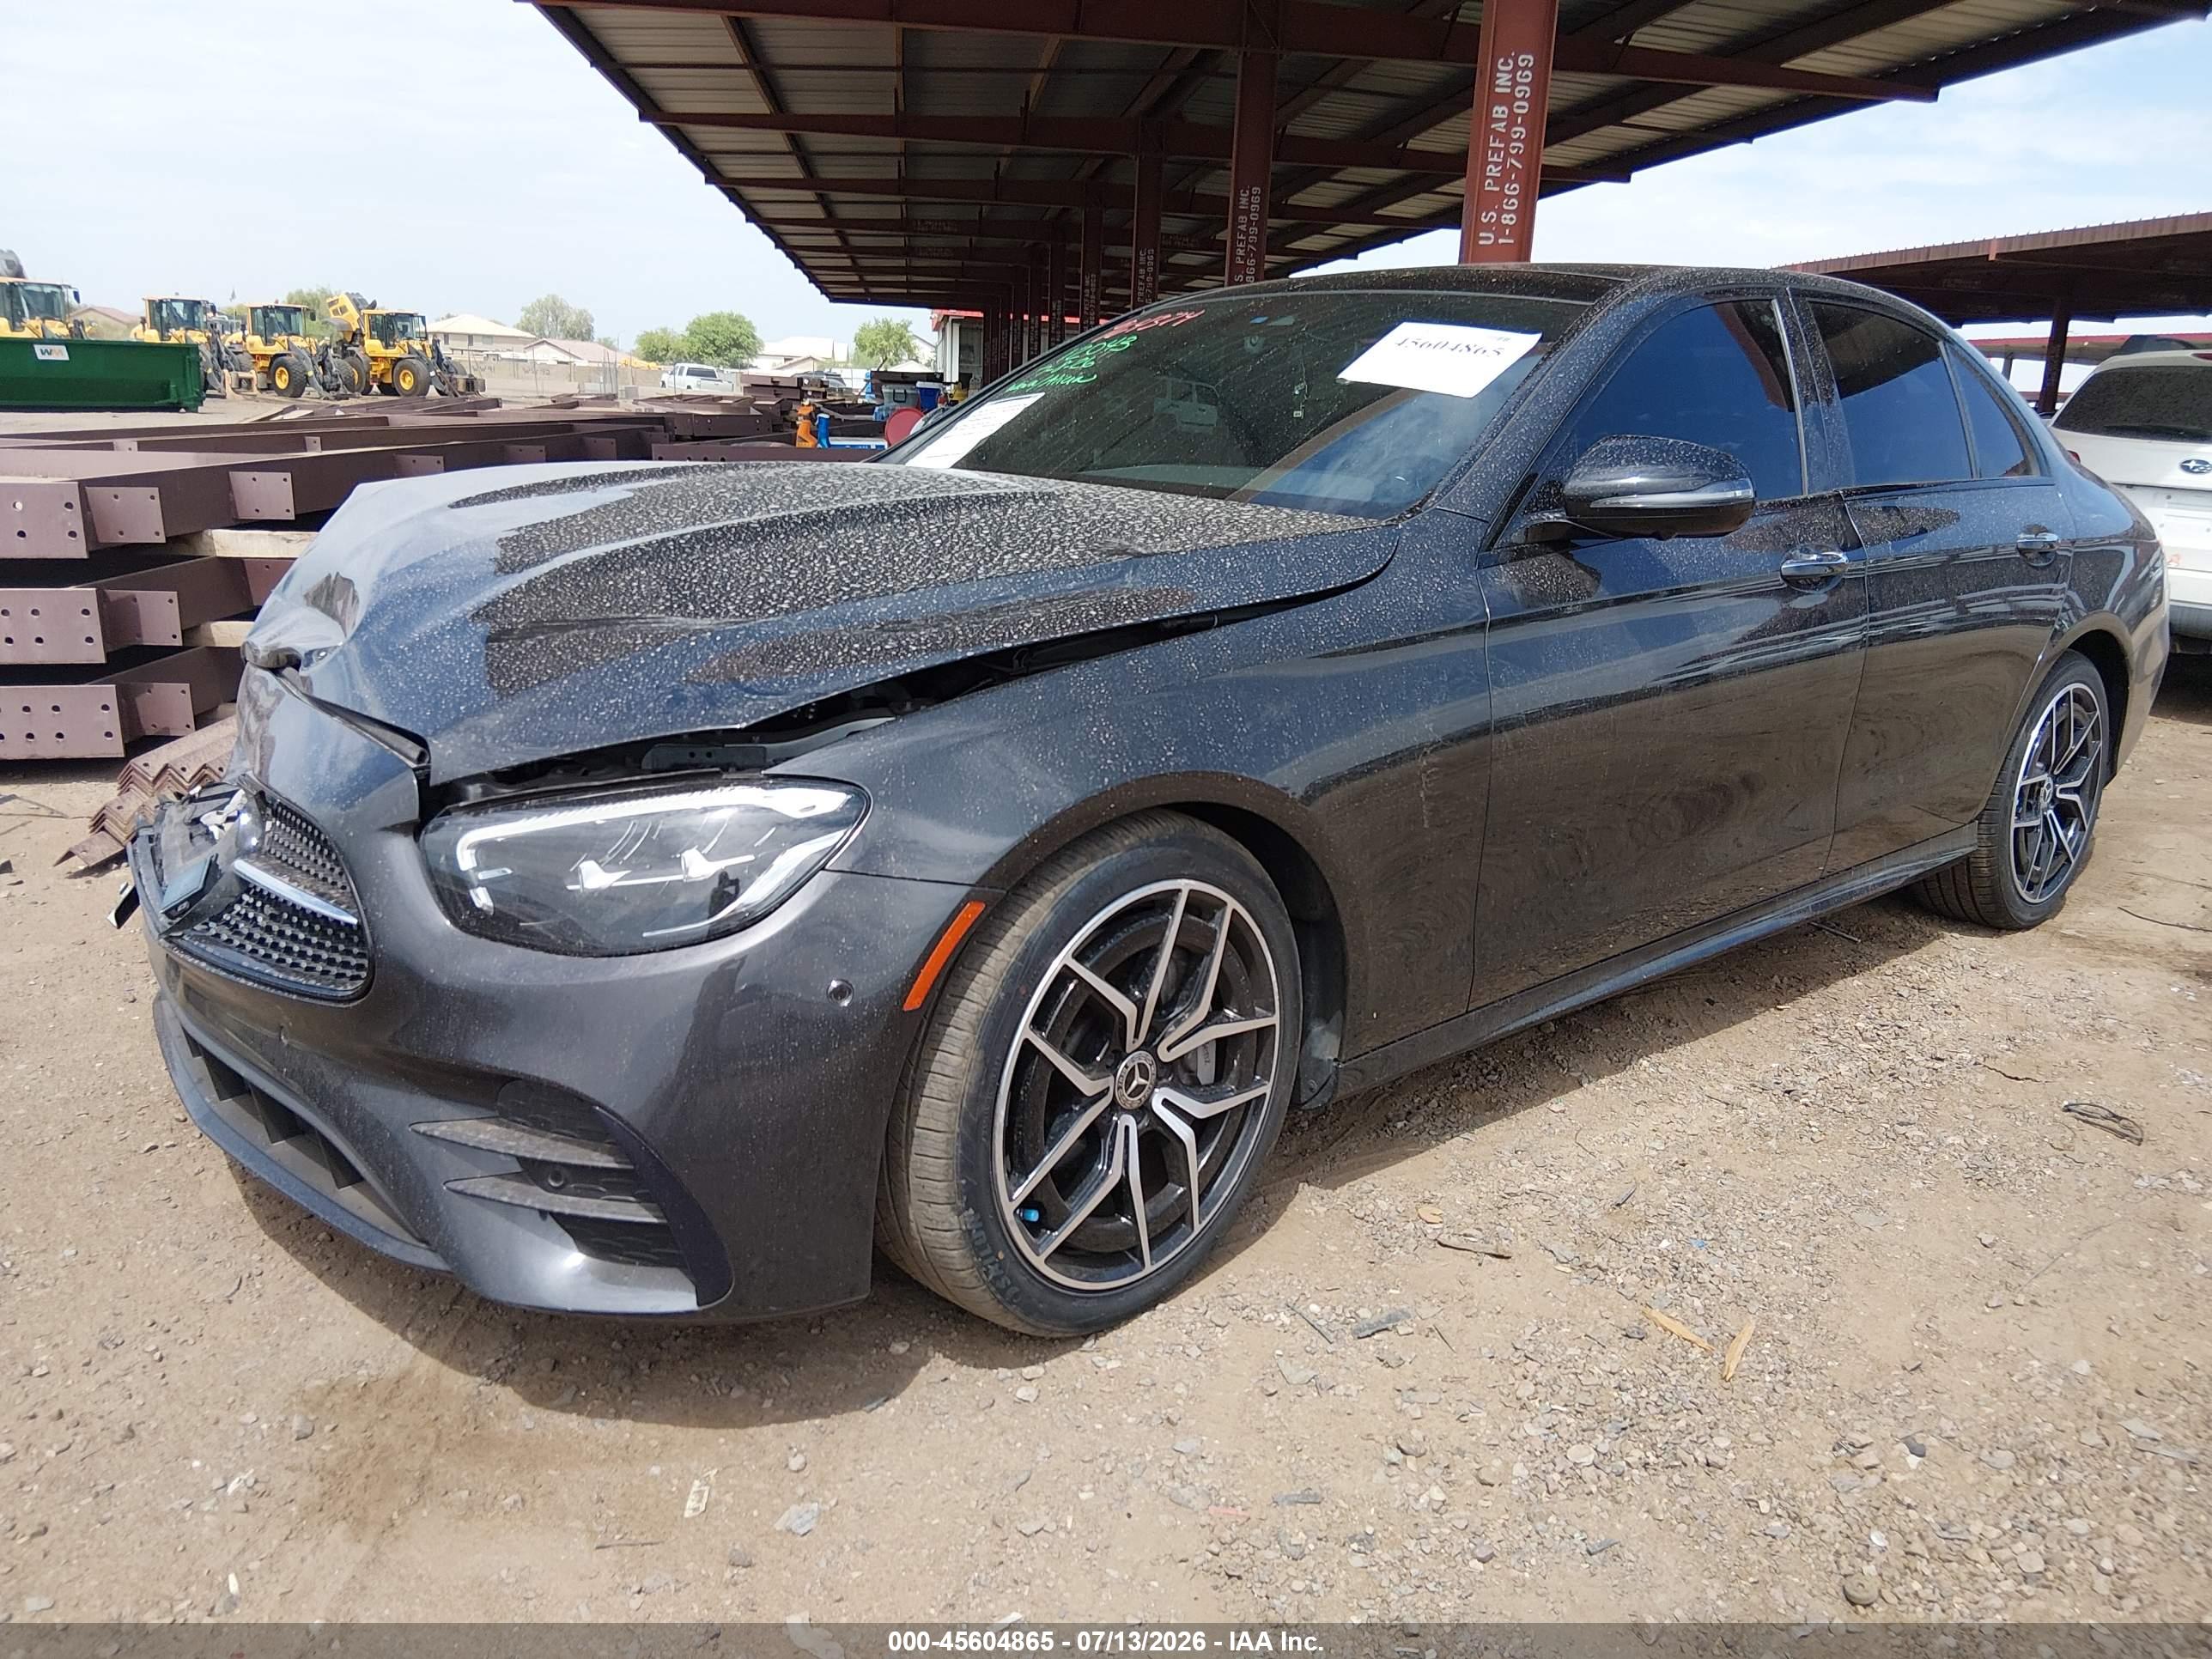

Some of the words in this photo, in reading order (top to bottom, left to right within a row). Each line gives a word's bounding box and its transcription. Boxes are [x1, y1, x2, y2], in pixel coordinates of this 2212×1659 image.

[1495, 51, 1516, 94] INC.
[1484, 104, 1509, 191] PREFAB
[1498, 53, 1534, 245] 1-866-799-0969
[1238, 185, 1250, 210] INC.
[1235, 215, 1248, 264] PREFAB
[1245, 186, 1261, 283] 866-799-0969
[1478, 204, 1498, 246] U.S.
[1145, 247, 1155, 304] 6-799-0969
[1395, 337, 1506, 357] 45604865
